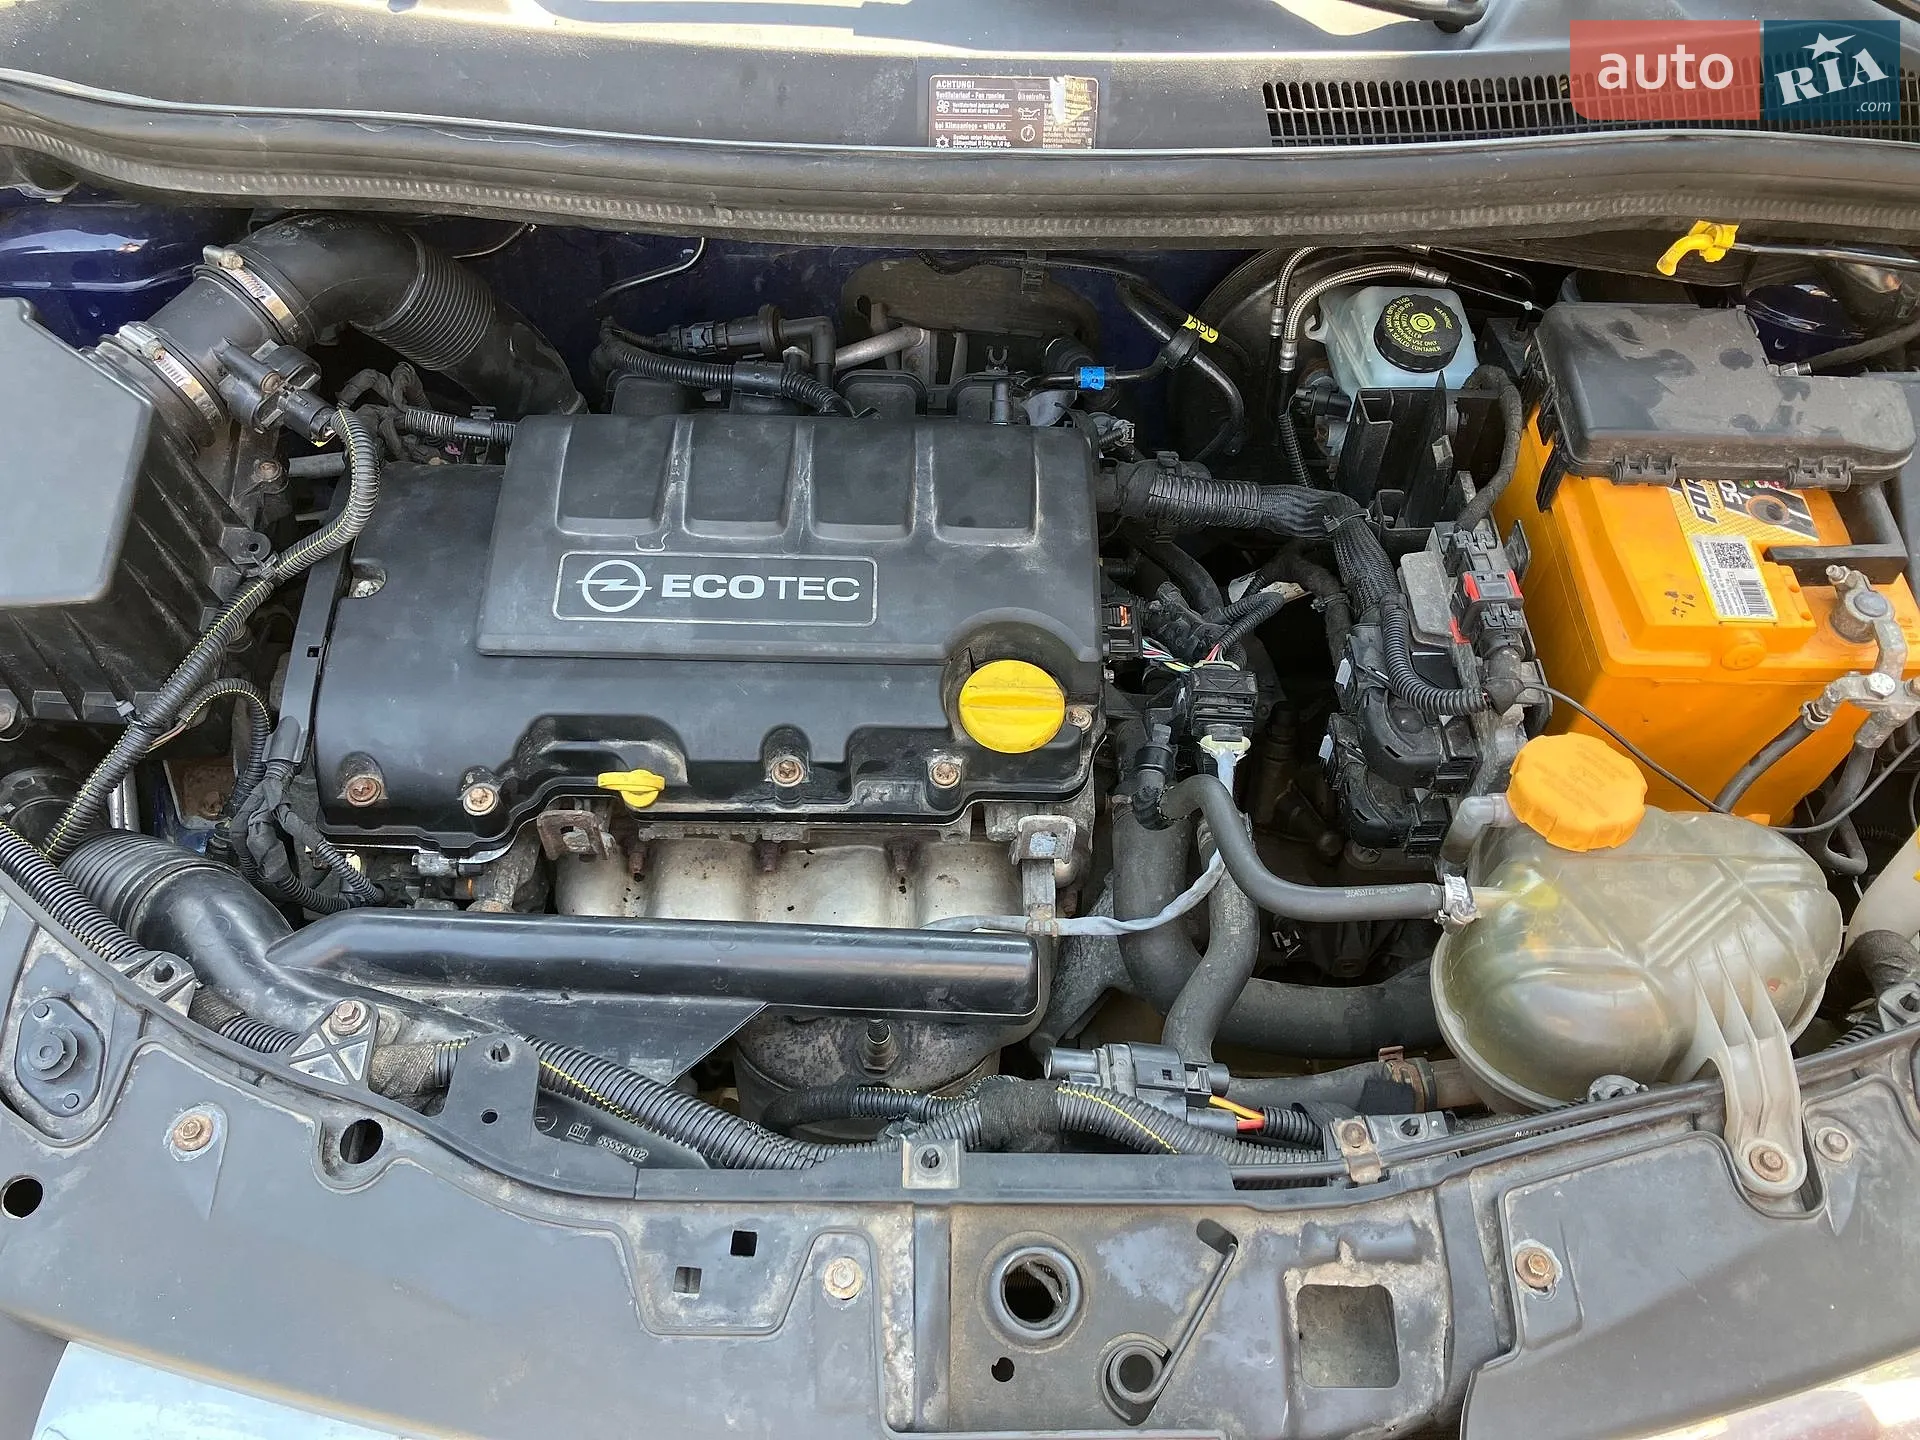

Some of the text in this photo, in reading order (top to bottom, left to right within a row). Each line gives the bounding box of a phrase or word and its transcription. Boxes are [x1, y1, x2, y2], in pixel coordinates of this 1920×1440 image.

[936, 80, 975, 89] ACHTUNG!
[1412, 344, 1441, 352] CONTAINER
[661, 574, 860, 602] ECOTEC
